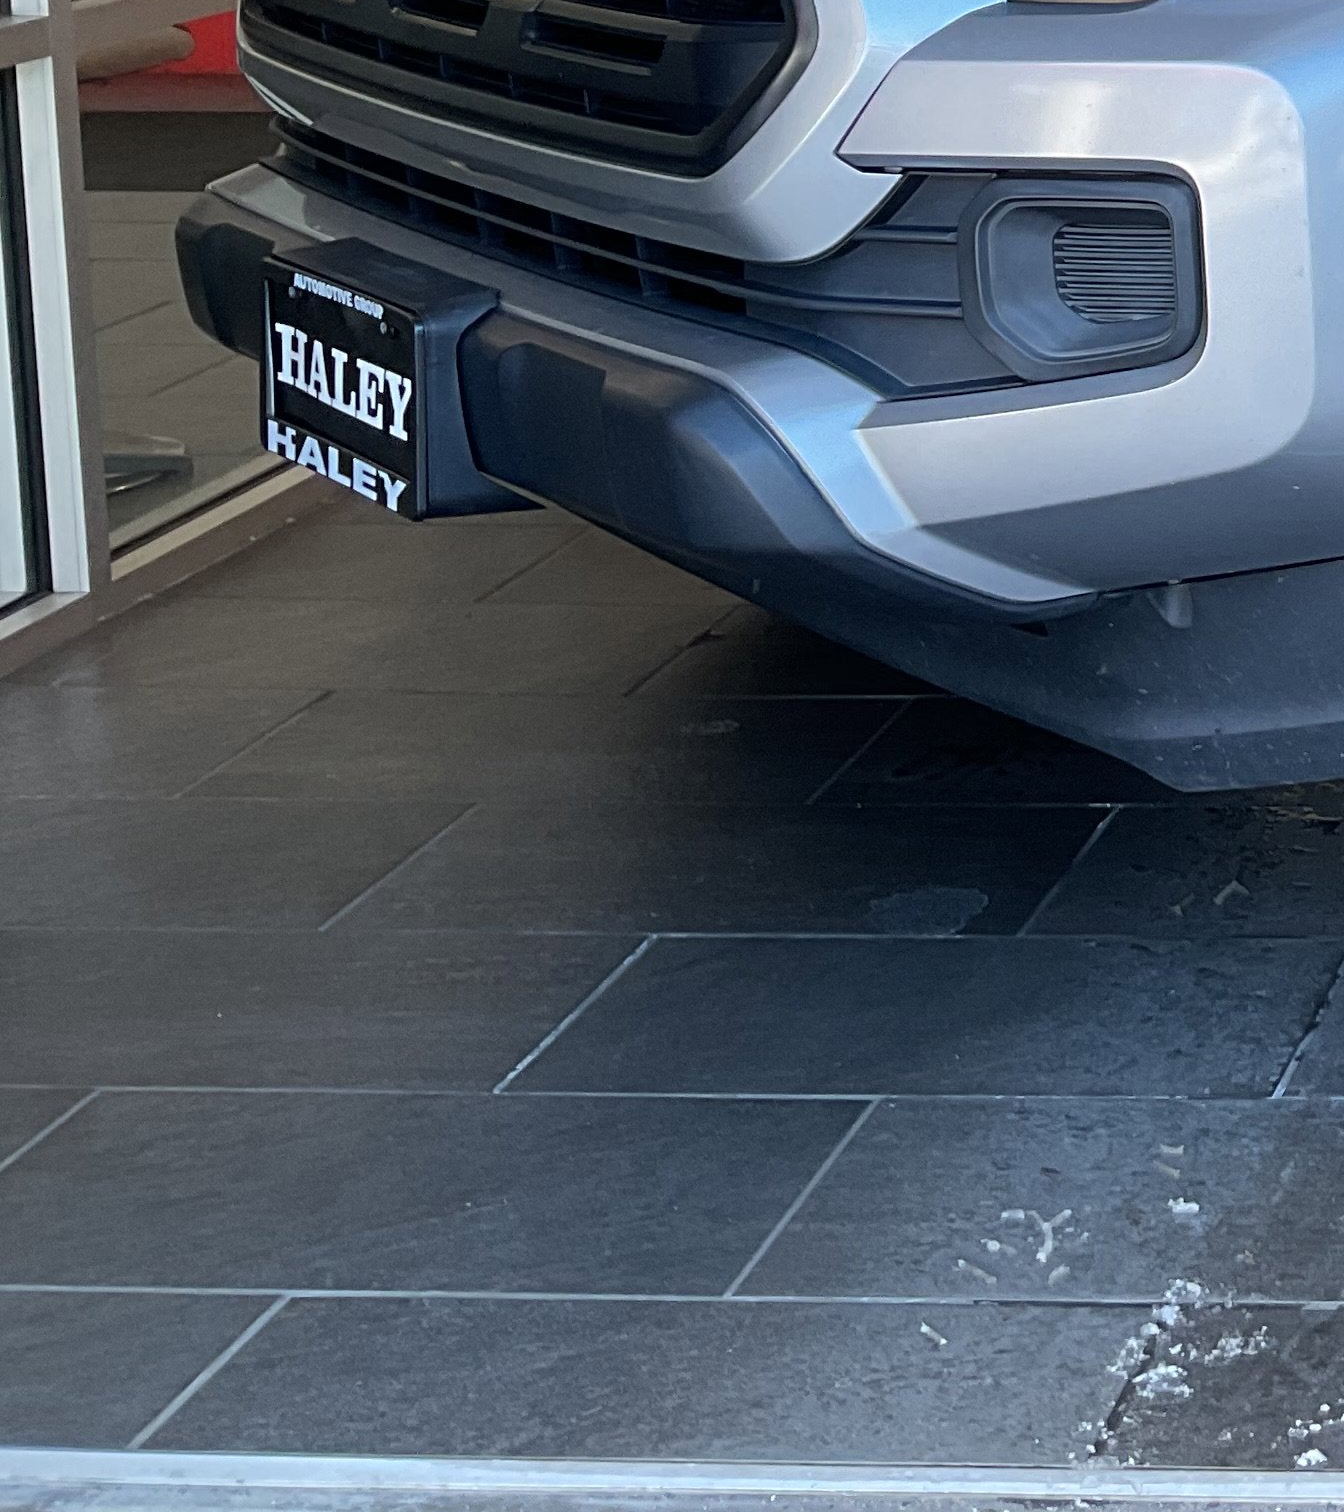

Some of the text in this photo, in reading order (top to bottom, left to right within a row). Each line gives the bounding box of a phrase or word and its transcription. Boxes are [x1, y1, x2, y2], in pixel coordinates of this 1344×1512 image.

[294, 272, 384, 320] AUTOMOTIVE GROUP
[275, 322, 412, 442] HALEY
[267, 418, 407, 513] HALEY
